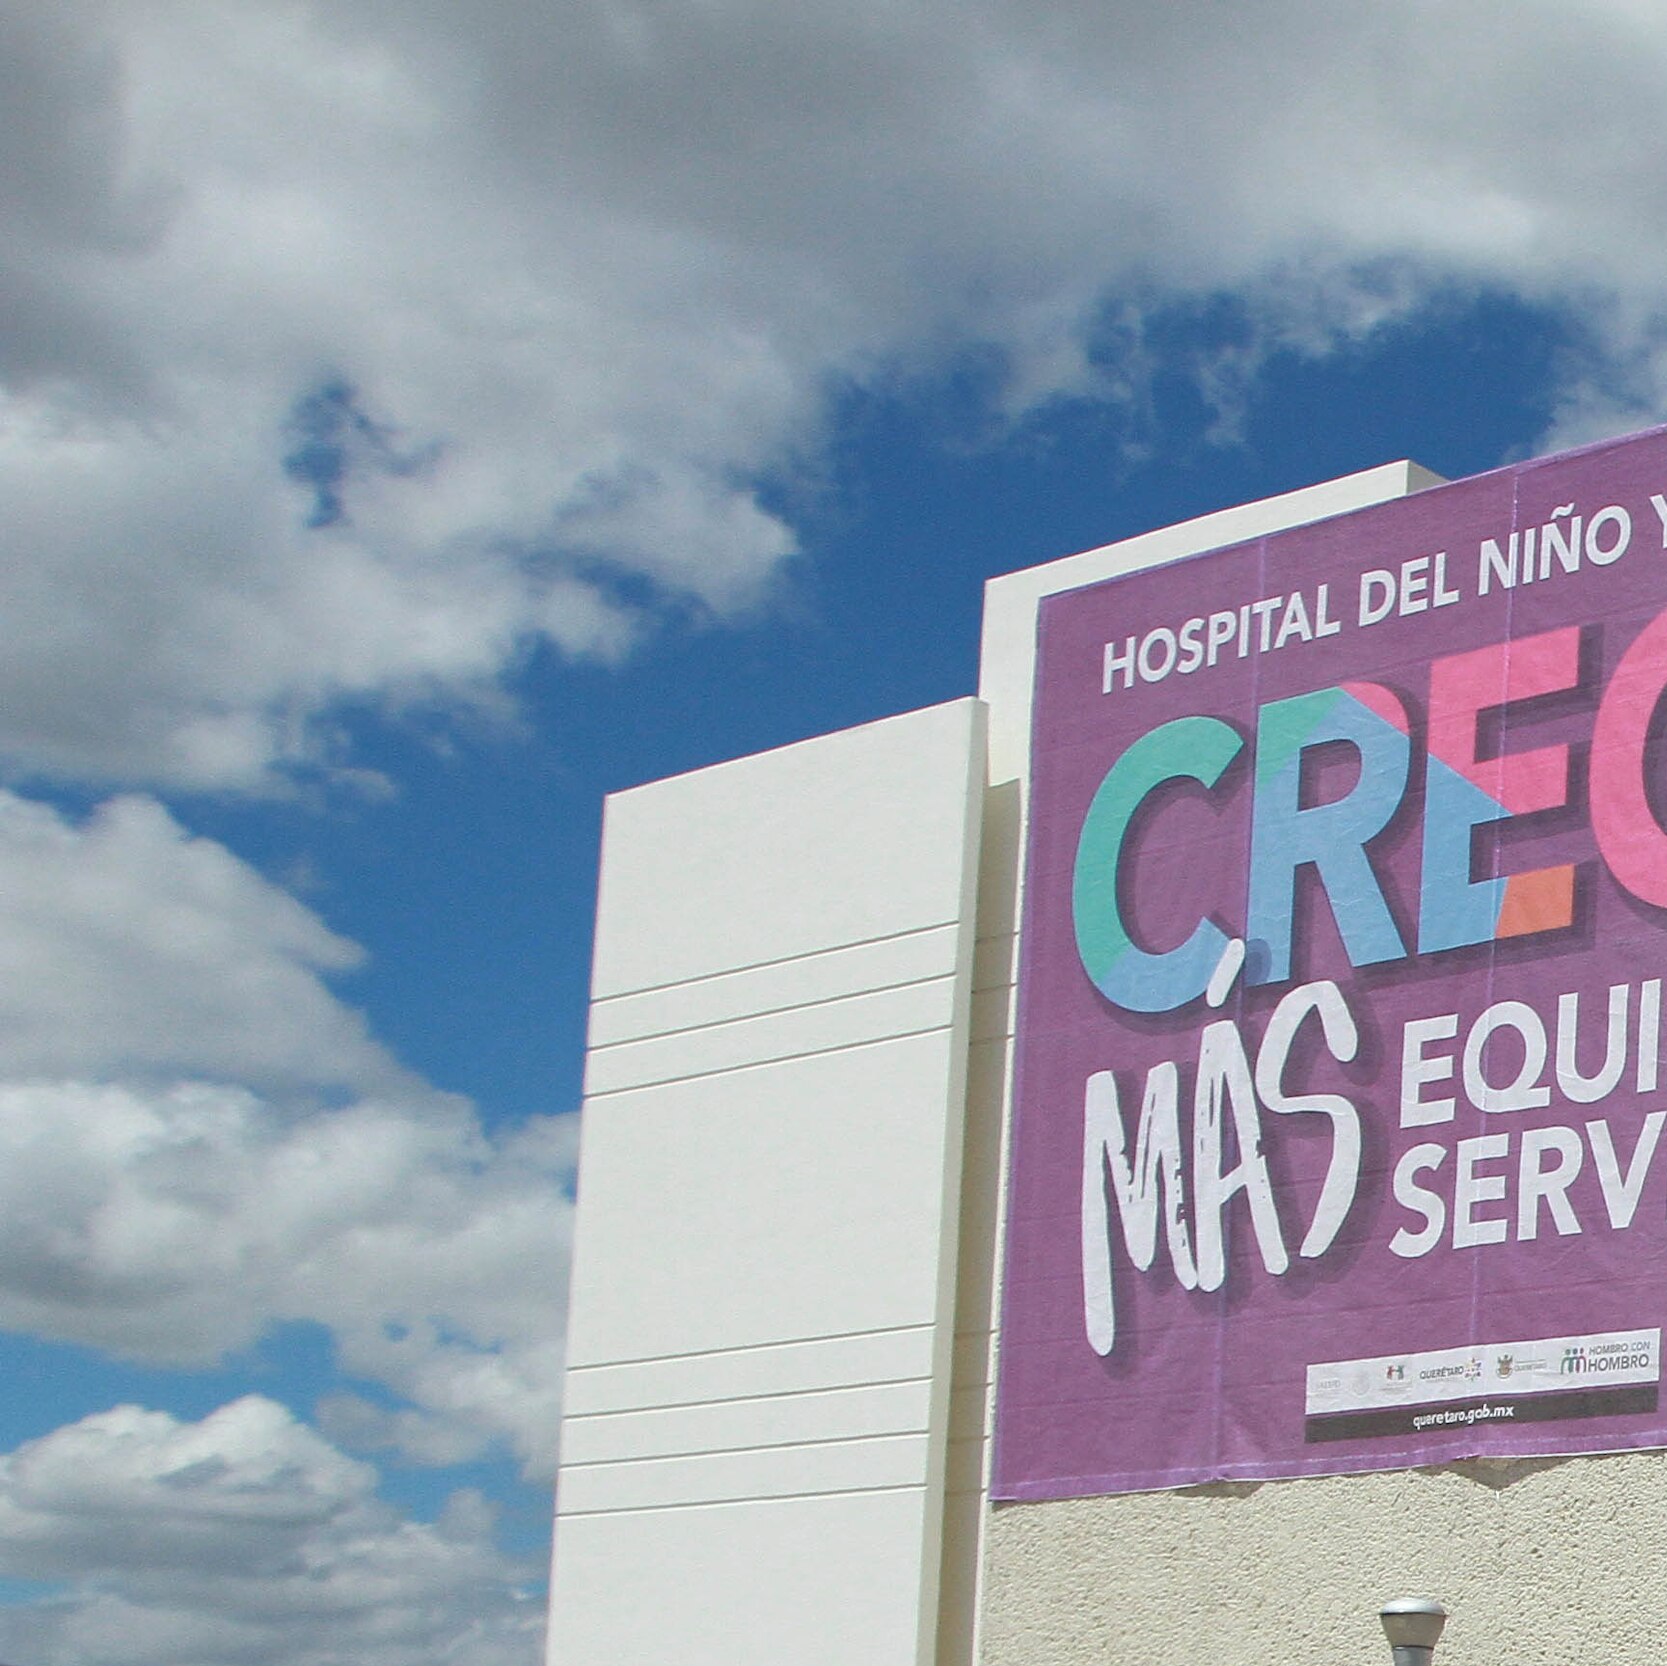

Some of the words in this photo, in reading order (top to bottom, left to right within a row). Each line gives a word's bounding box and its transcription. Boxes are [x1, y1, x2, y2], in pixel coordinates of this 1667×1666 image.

[1102, 590, 1340, 694] HOSPITAL
[1358, 556, 1457, 628] DEL
[1478, 504, 1632, 588] NIÑO
[1081, 938, 1363, 1357] MÁS
[1588, 1343, 1629, 1355] HOMBRO
[1631, 1341, 1651, 1351] CON
[1588, 1354, 1650, 1372] HOMBRO
[1413, 1404, 1515, 1430] queretaro.gob.mx
